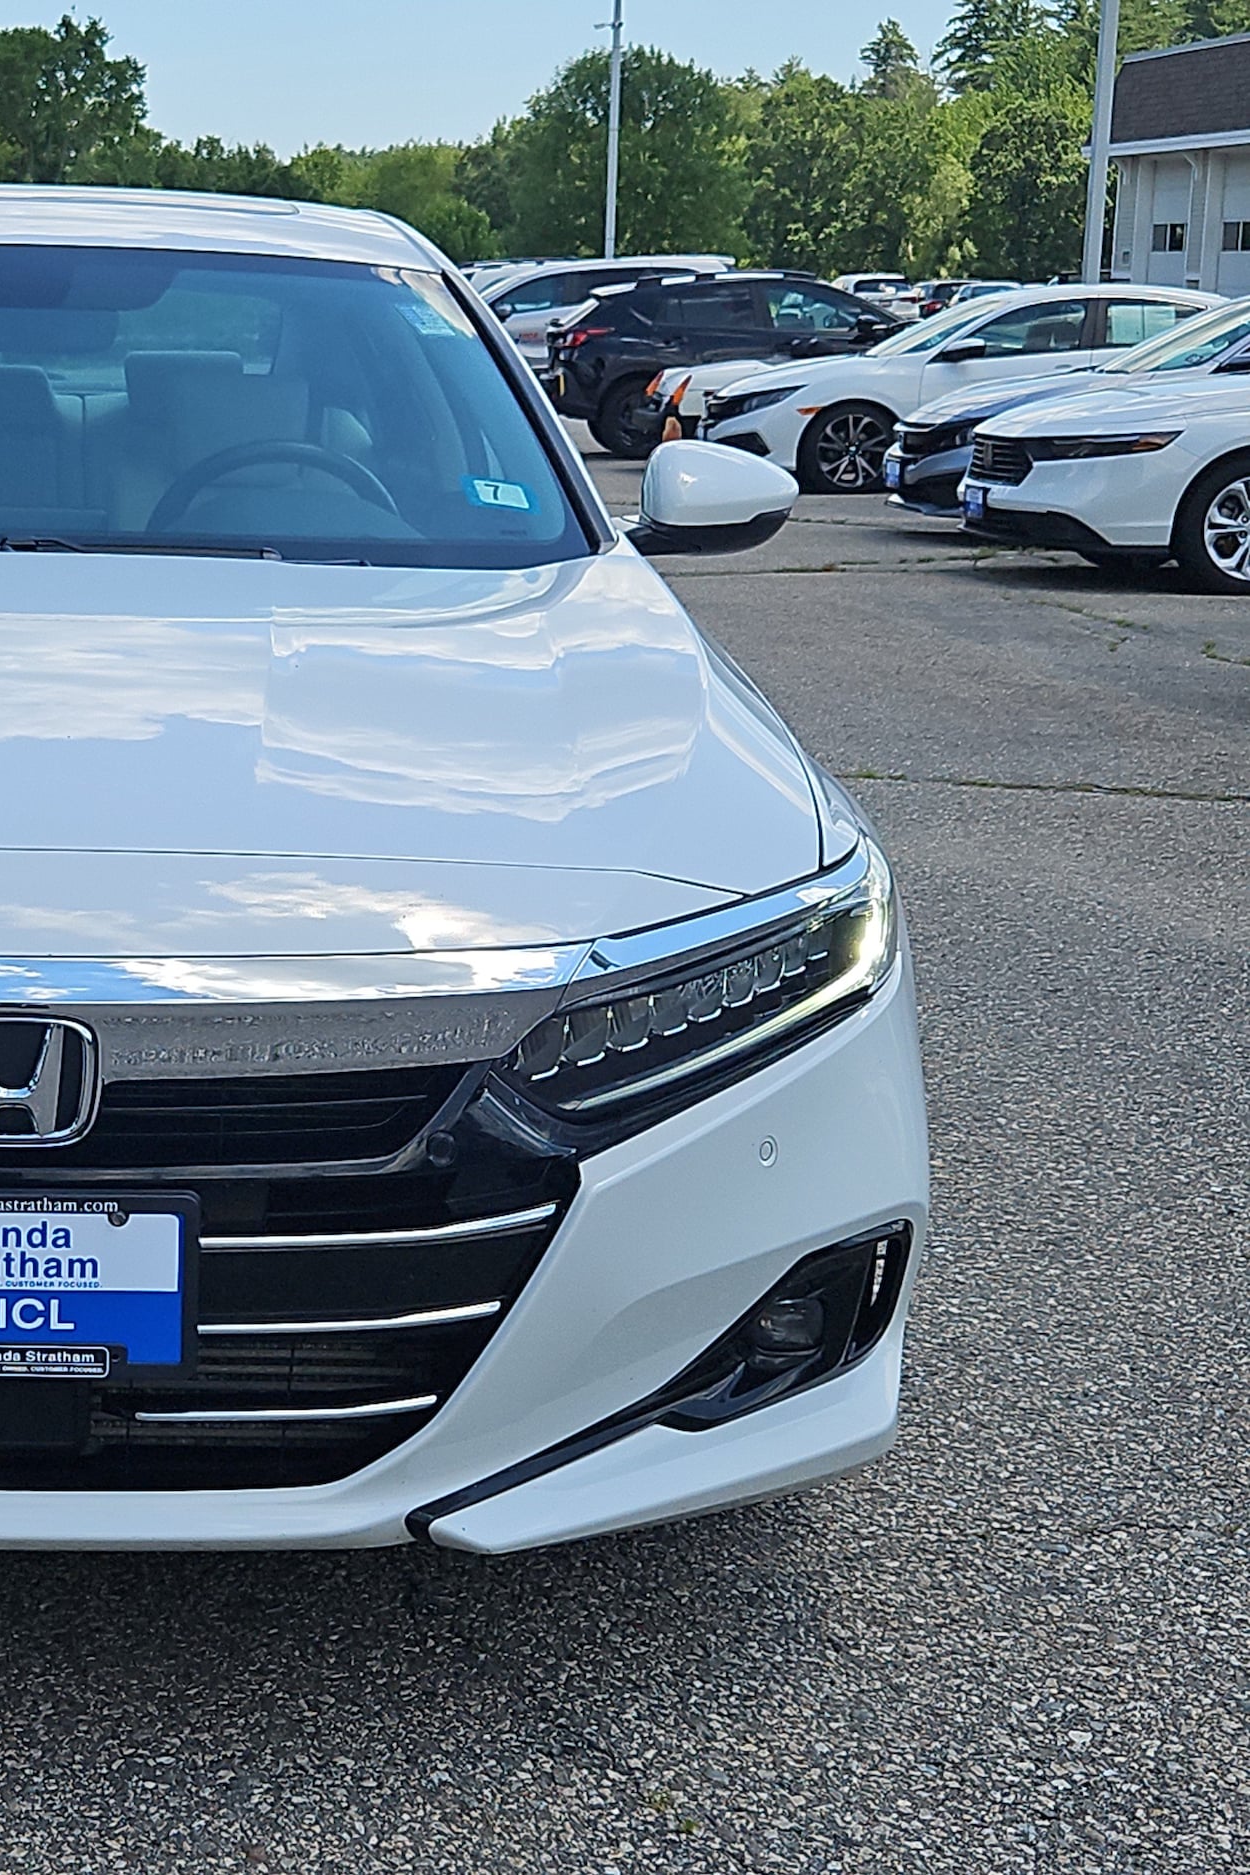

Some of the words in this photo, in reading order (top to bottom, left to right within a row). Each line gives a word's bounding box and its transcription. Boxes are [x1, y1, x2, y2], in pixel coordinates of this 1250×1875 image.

[484, 483, 499, 501] 7
[5, 1280, 55, 1288] CUSTOMER
[25, 1351, 95, 1363] Stratham
